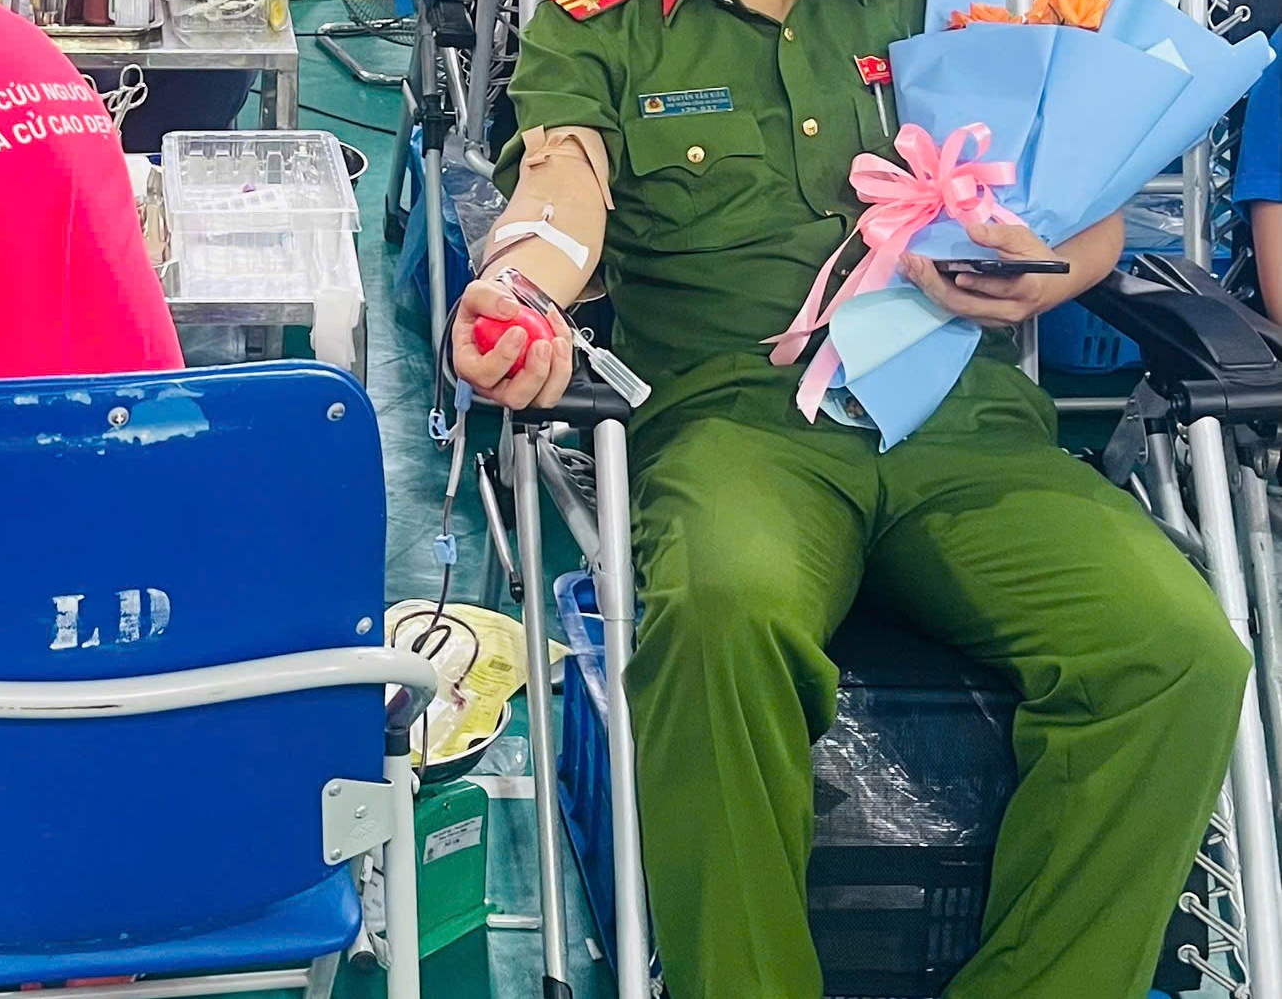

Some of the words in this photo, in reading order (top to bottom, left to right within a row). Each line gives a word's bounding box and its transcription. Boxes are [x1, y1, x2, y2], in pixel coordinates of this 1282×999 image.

[39, 81, 95, 102] NGƯỜI
[11, 110, 48, 145] CỬ
[47, 114, 85, 136] CAO
